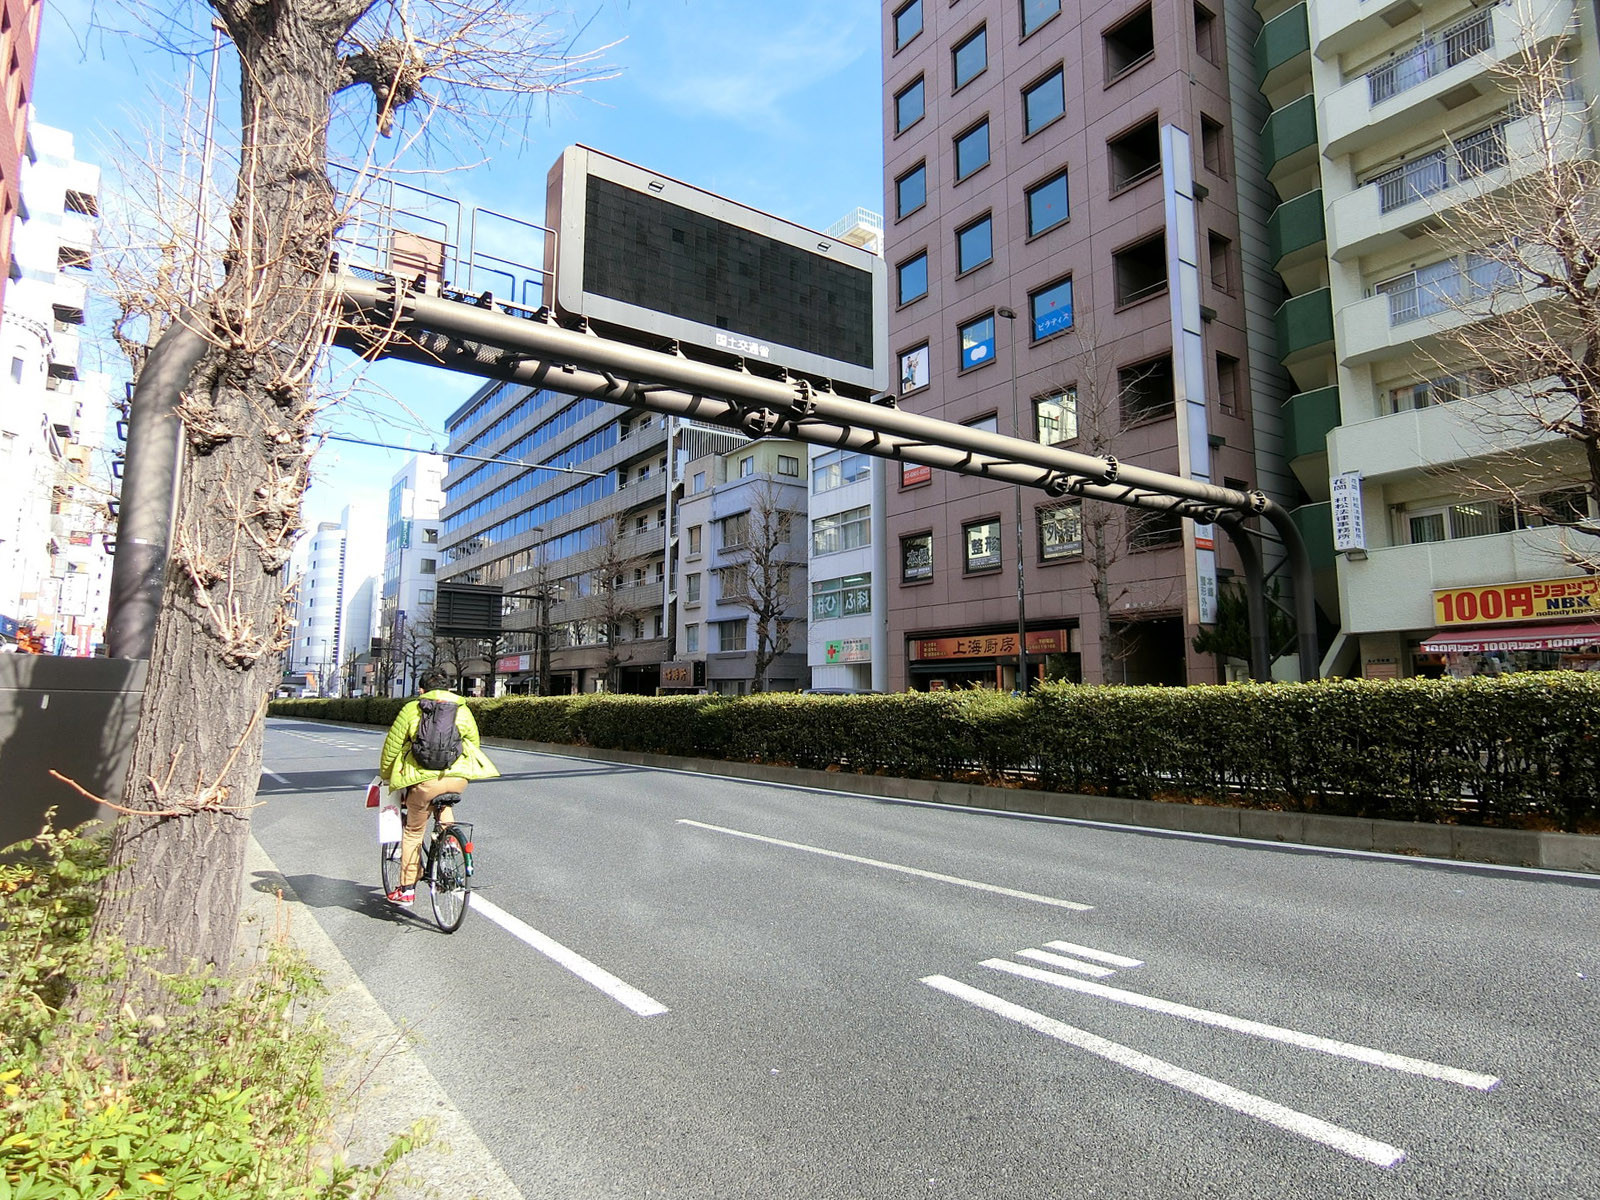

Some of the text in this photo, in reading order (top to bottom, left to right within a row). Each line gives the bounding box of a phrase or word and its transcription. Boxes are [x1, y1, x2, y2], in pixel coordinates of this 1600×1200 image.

[1038, 313, 1069, 331] ピラティス
[716, 333, 769, 358] 国土交通省
[1045, 519, 1077, 541] 外科
[971, 536, 998, 556] 整形
[1437, 586, 1534, 622] 100円
[1546, 595, 1592, 610] NBK
[1536, 609, 1570, 617] nobody
[952, 637, 1016, 655] 上海厨房
[1483, 640, 1542, 651] 100円ショップ
